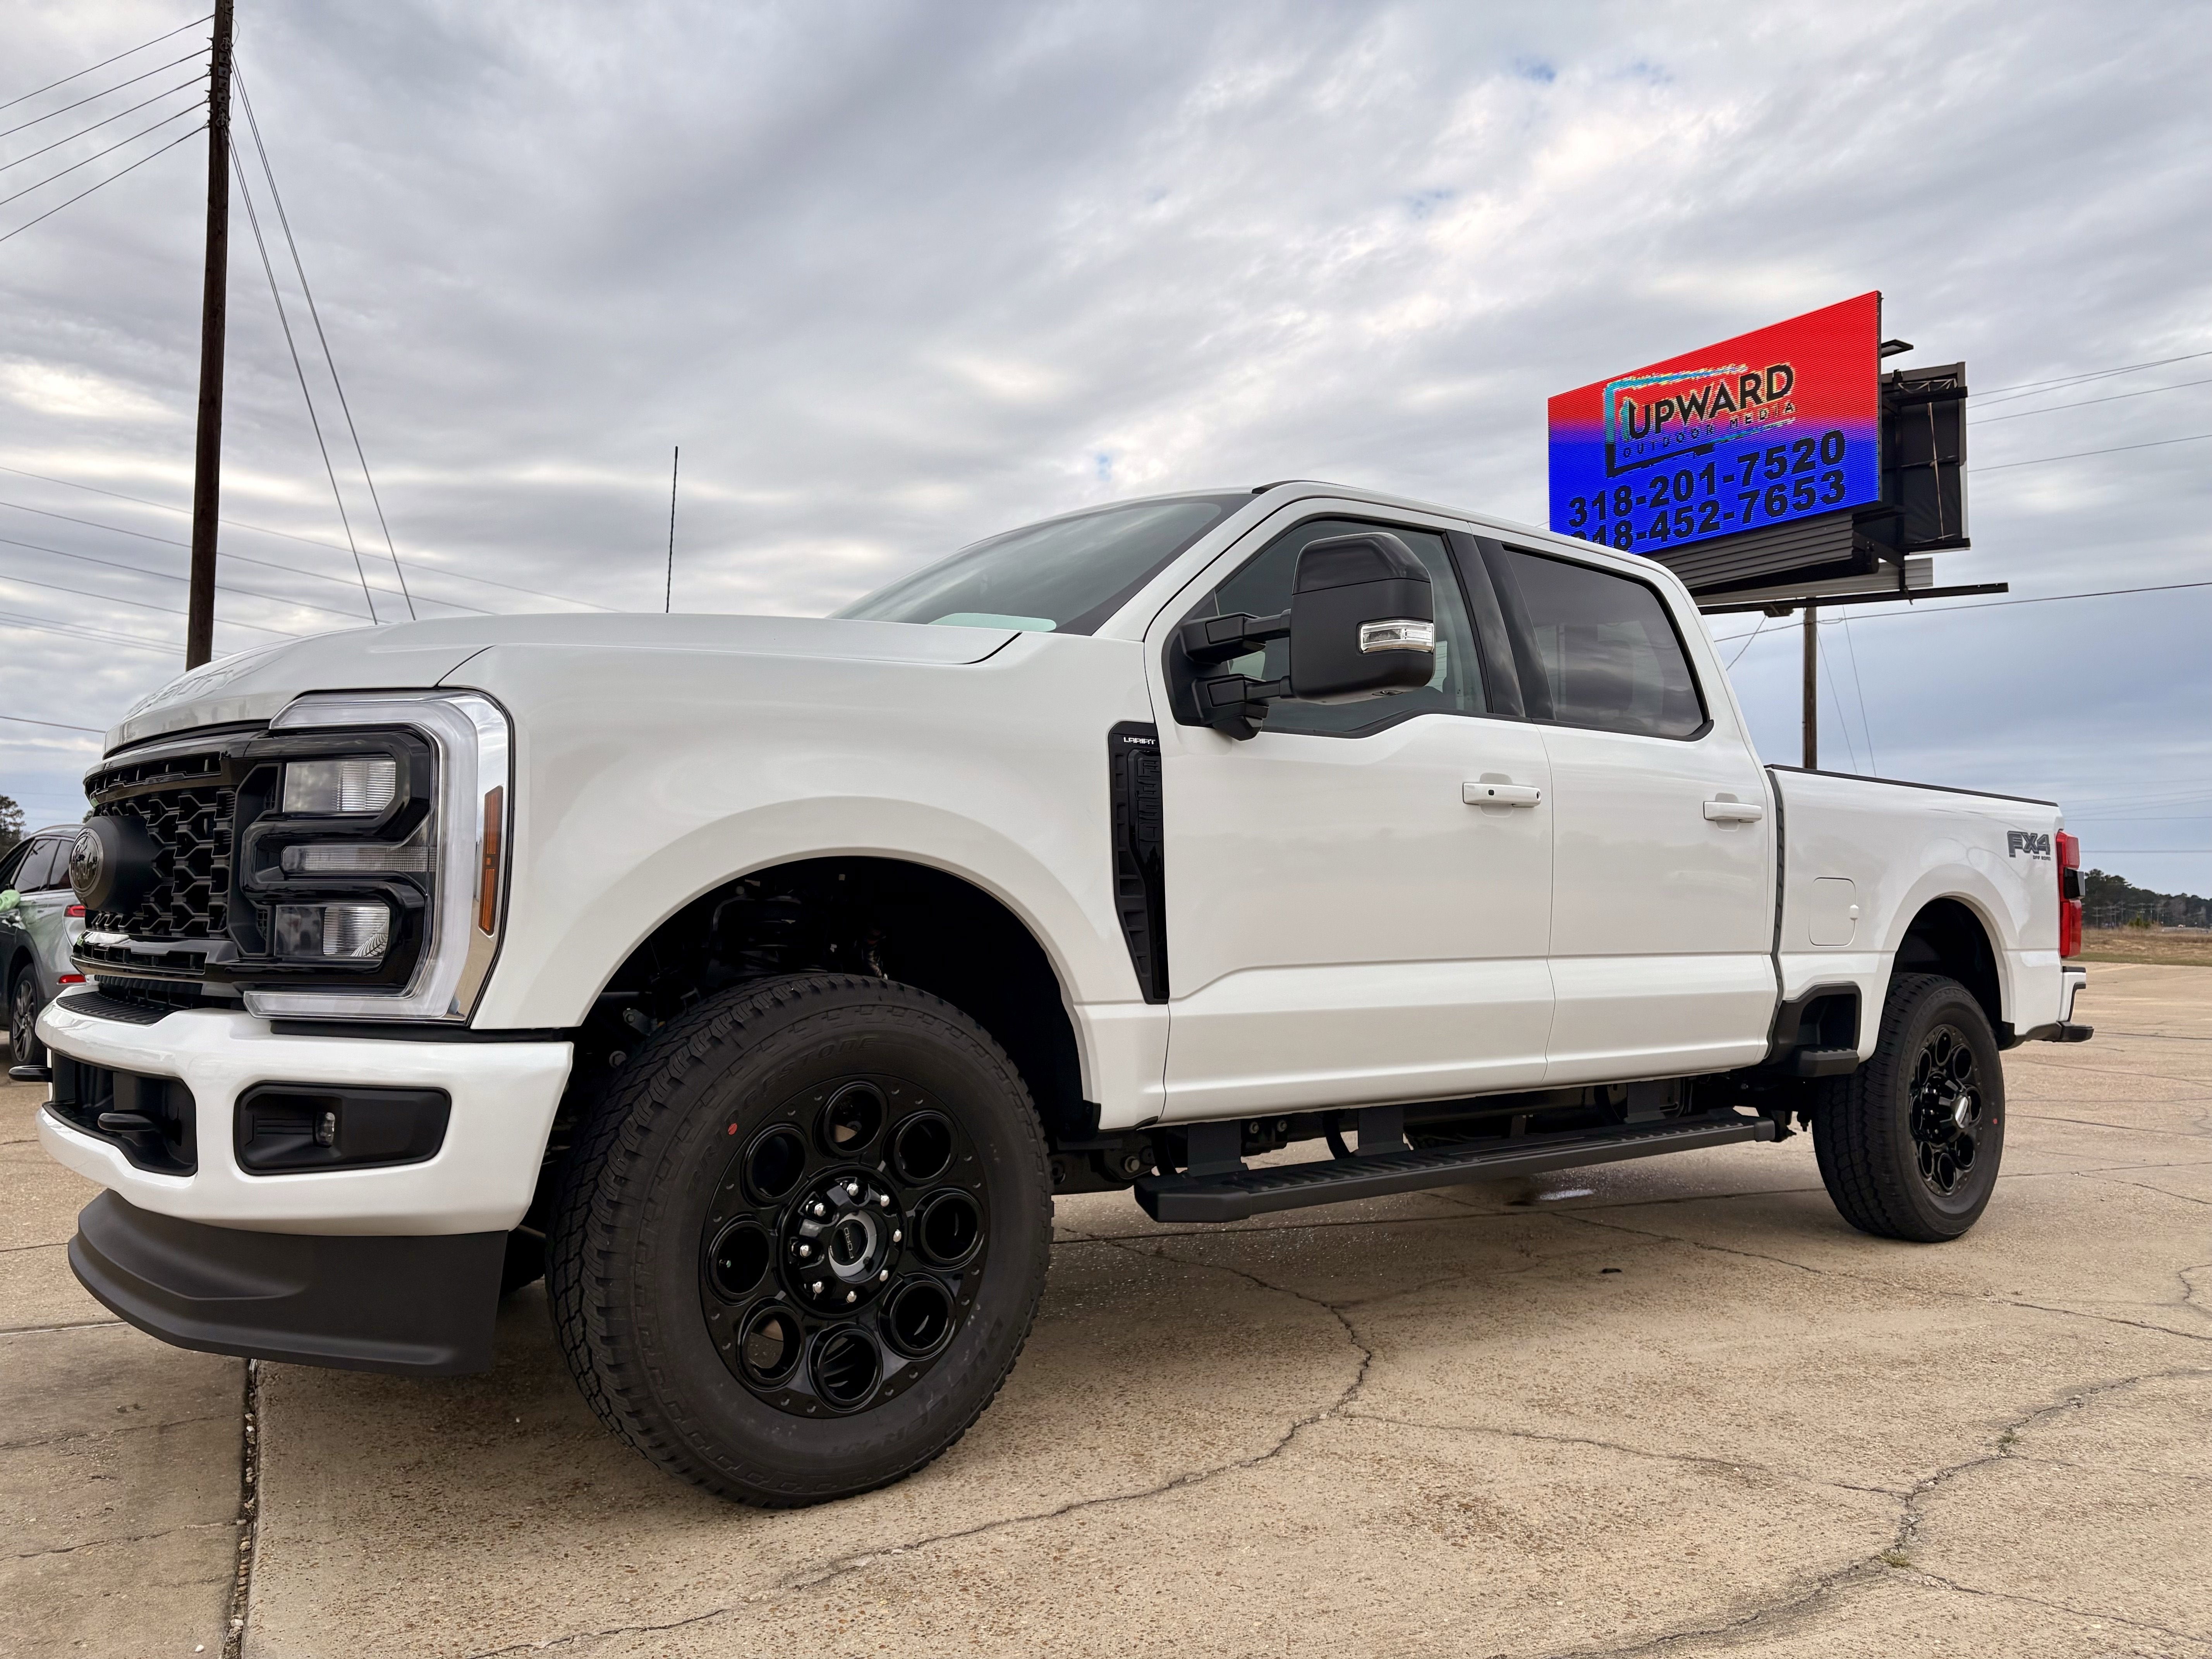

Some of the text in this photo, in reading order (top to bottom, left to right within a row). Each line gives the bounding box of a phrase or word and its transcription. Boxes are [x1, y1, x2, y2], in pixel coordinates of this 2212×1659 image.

[1624, 402, 1795, 457] OUTDOOR MEDIA
[1628, 364, 1794, 439] UPWARD
[1568, 429, 1845, 527] 318-201-7520
[2007, 831, 2051, 858] FX4
[685, 1035, 880, 1197] BRIDGESTONE
[843, 1227, 855, 1259] FORD
